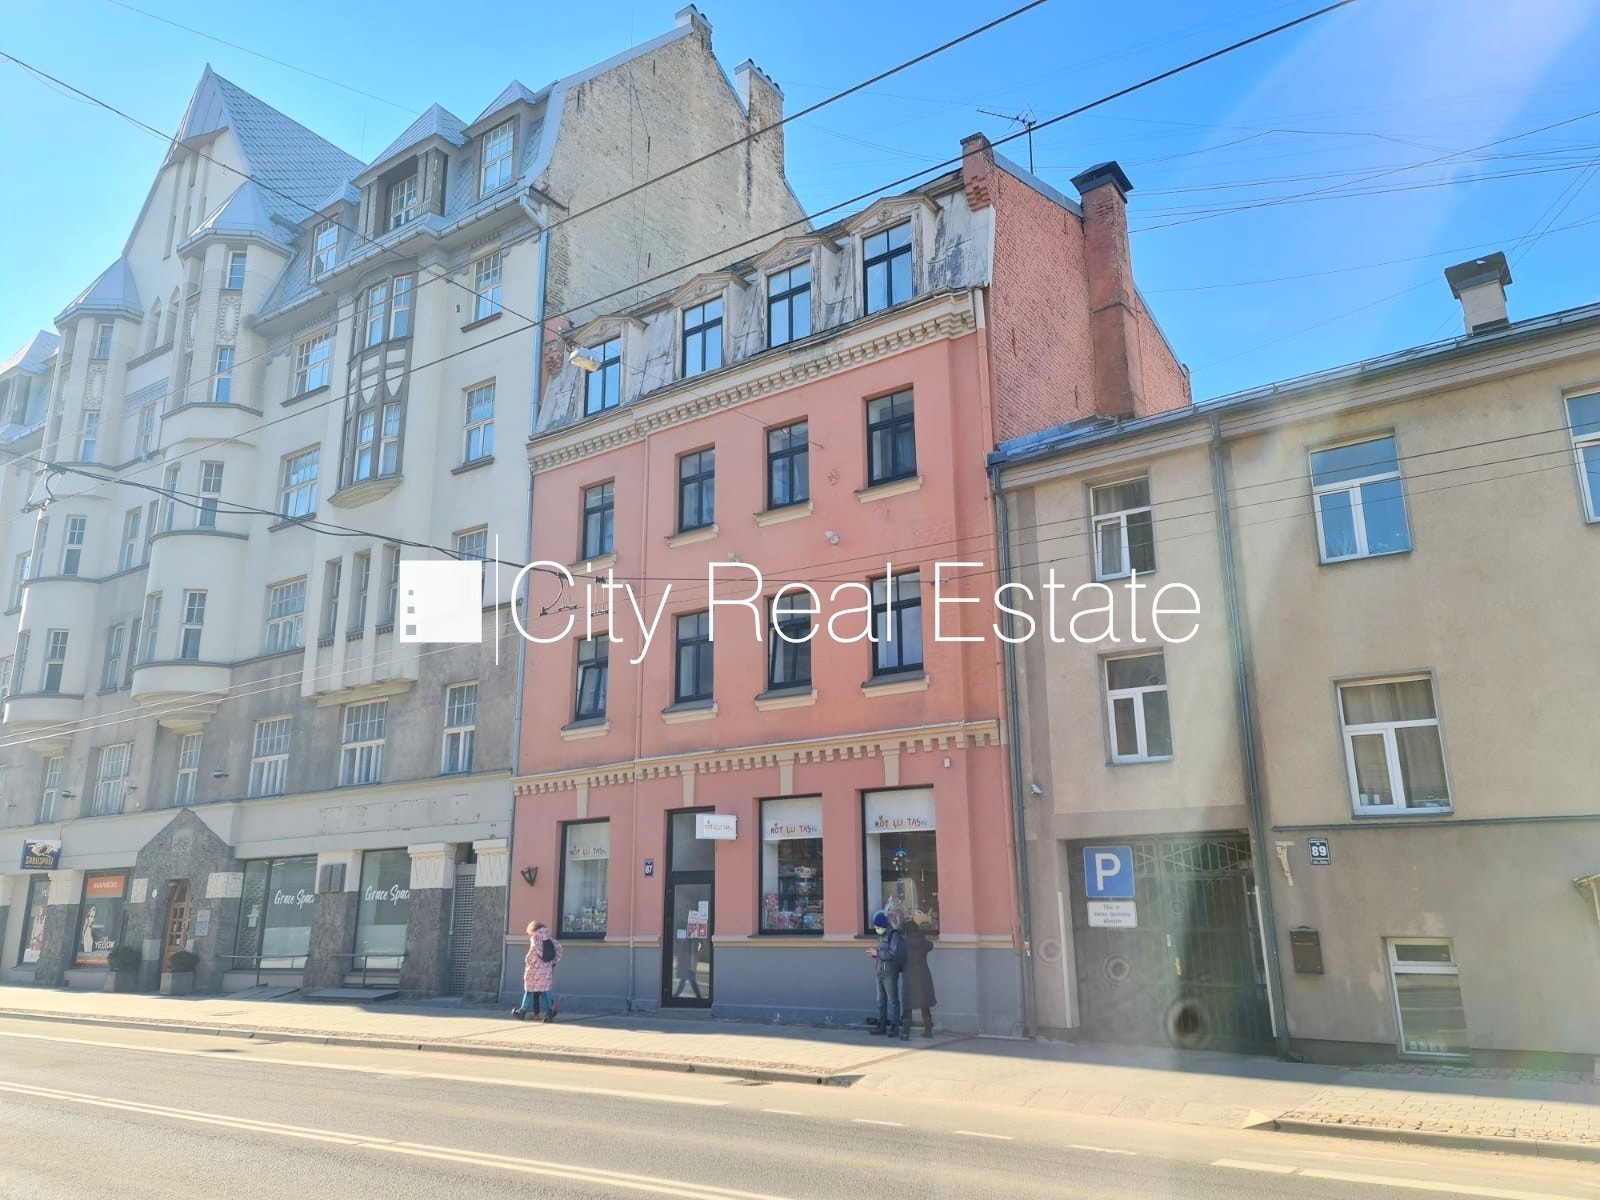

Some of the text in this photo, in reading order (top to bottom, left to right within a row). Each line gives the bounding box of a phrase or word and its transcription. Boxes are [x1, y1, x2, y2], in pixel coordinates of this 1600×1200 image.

[1311, 845, 1327, 857] 89
[645, 865, 653, 874] 87
[1095, 853, 1121, 891] P
[274, 888, 315, 910] Grace Spac
[365, 884, 410, 907] Grace Spac
